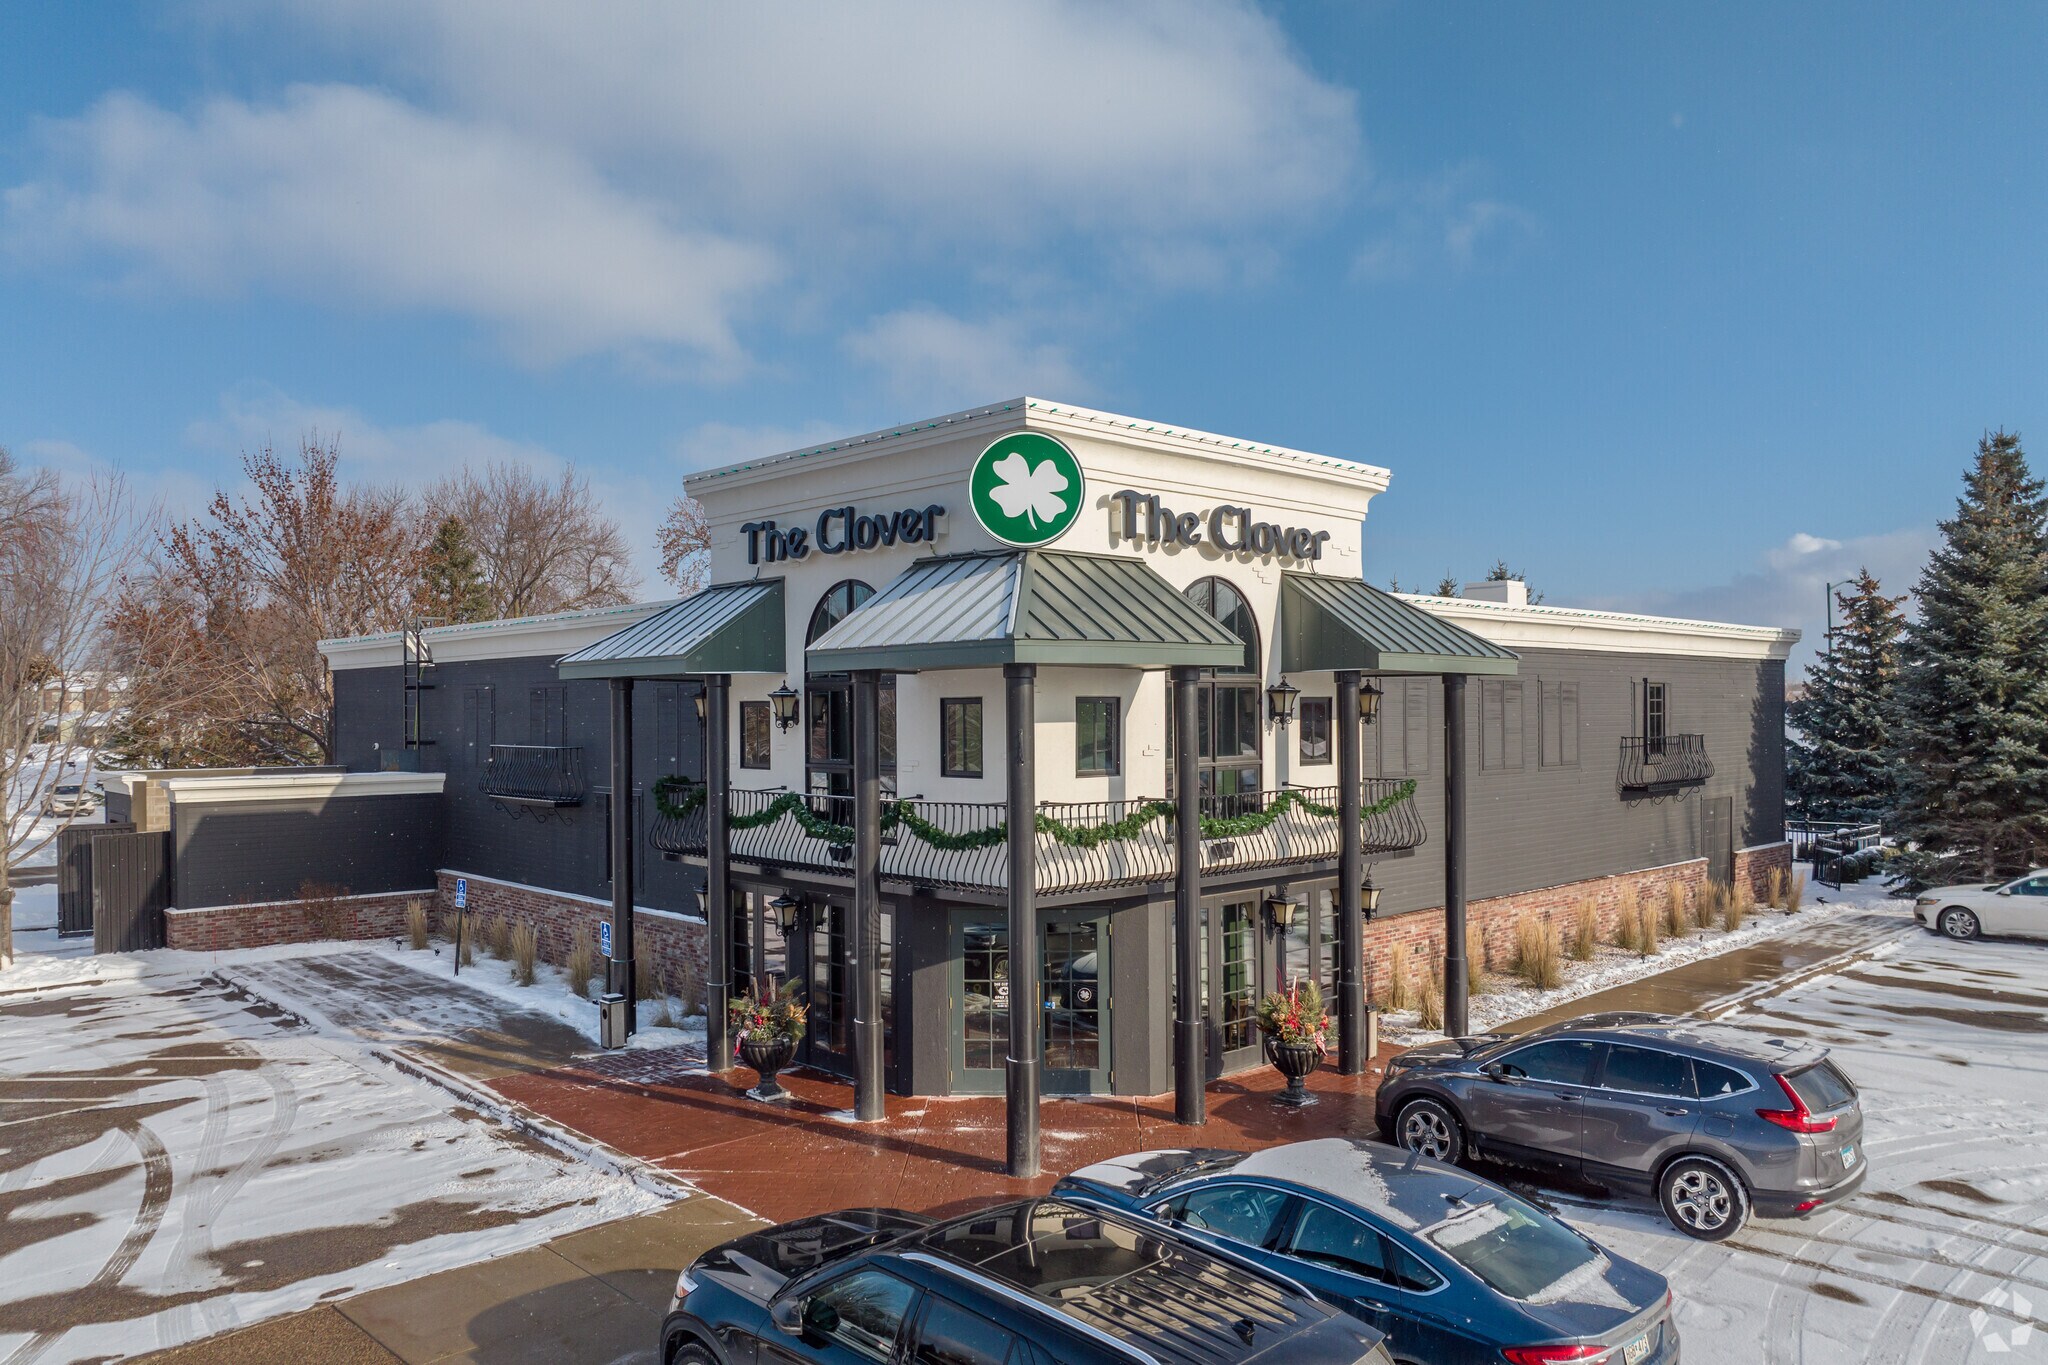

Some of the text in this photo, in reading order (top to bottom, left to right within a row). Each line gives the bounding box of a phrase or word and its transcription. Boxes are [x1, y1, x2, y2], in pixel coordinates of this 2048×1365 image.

[740, 504, 946, 565] The Clover
[1111, 489, 1331, 561] The Clover
